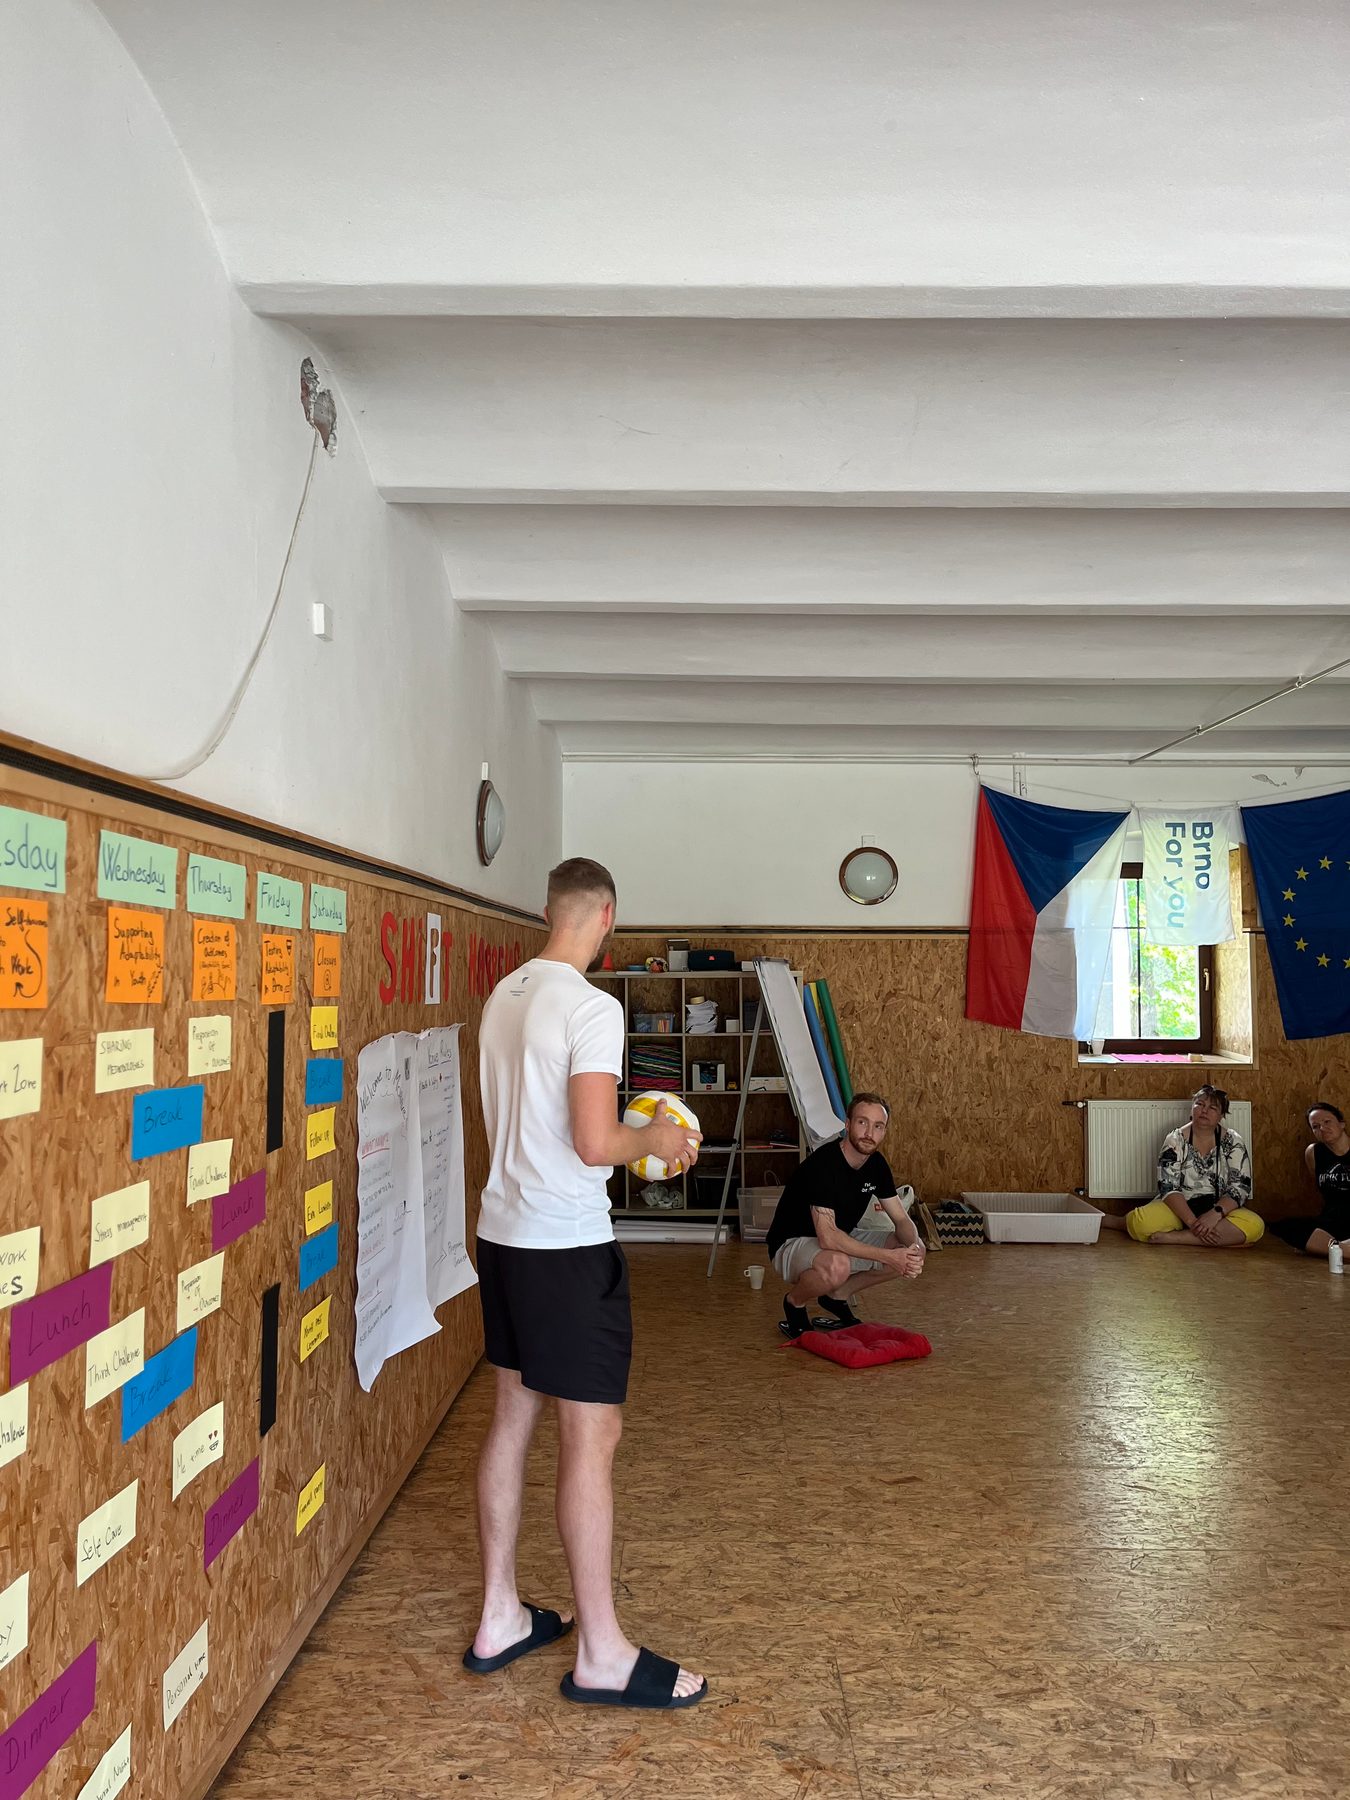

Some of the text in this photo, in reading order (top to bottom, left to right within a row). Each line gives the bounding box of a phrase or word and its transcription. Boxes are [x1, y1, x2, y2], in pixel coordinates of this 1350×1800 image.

[0, 822, 58, 888] sday
[102, 842, 166, 893] Wednesday
[1163, 822, 1186, 929] For you
[1191, 821, 1214, 890] Brno
[190, 865, 232, 902] Thursday
[260, 882, 290, 917] Friday
[311, 891, 343, 926] Saturday
[114, 916, 155, 945] Supporting
[99, 1039, 132, 1055] SHARING
[144, 1105, 184, 1134] Break
[221, 1190, 253, 1230] Lunch
[28, 1289, 91, 1357] Lunch
[88, 1361, 112, 1388] Third
[129, 1367, 174, 1417] Break
[166, 1666, 193, 1710] Personal
[5, 1687, 71, 1775] Dinner
